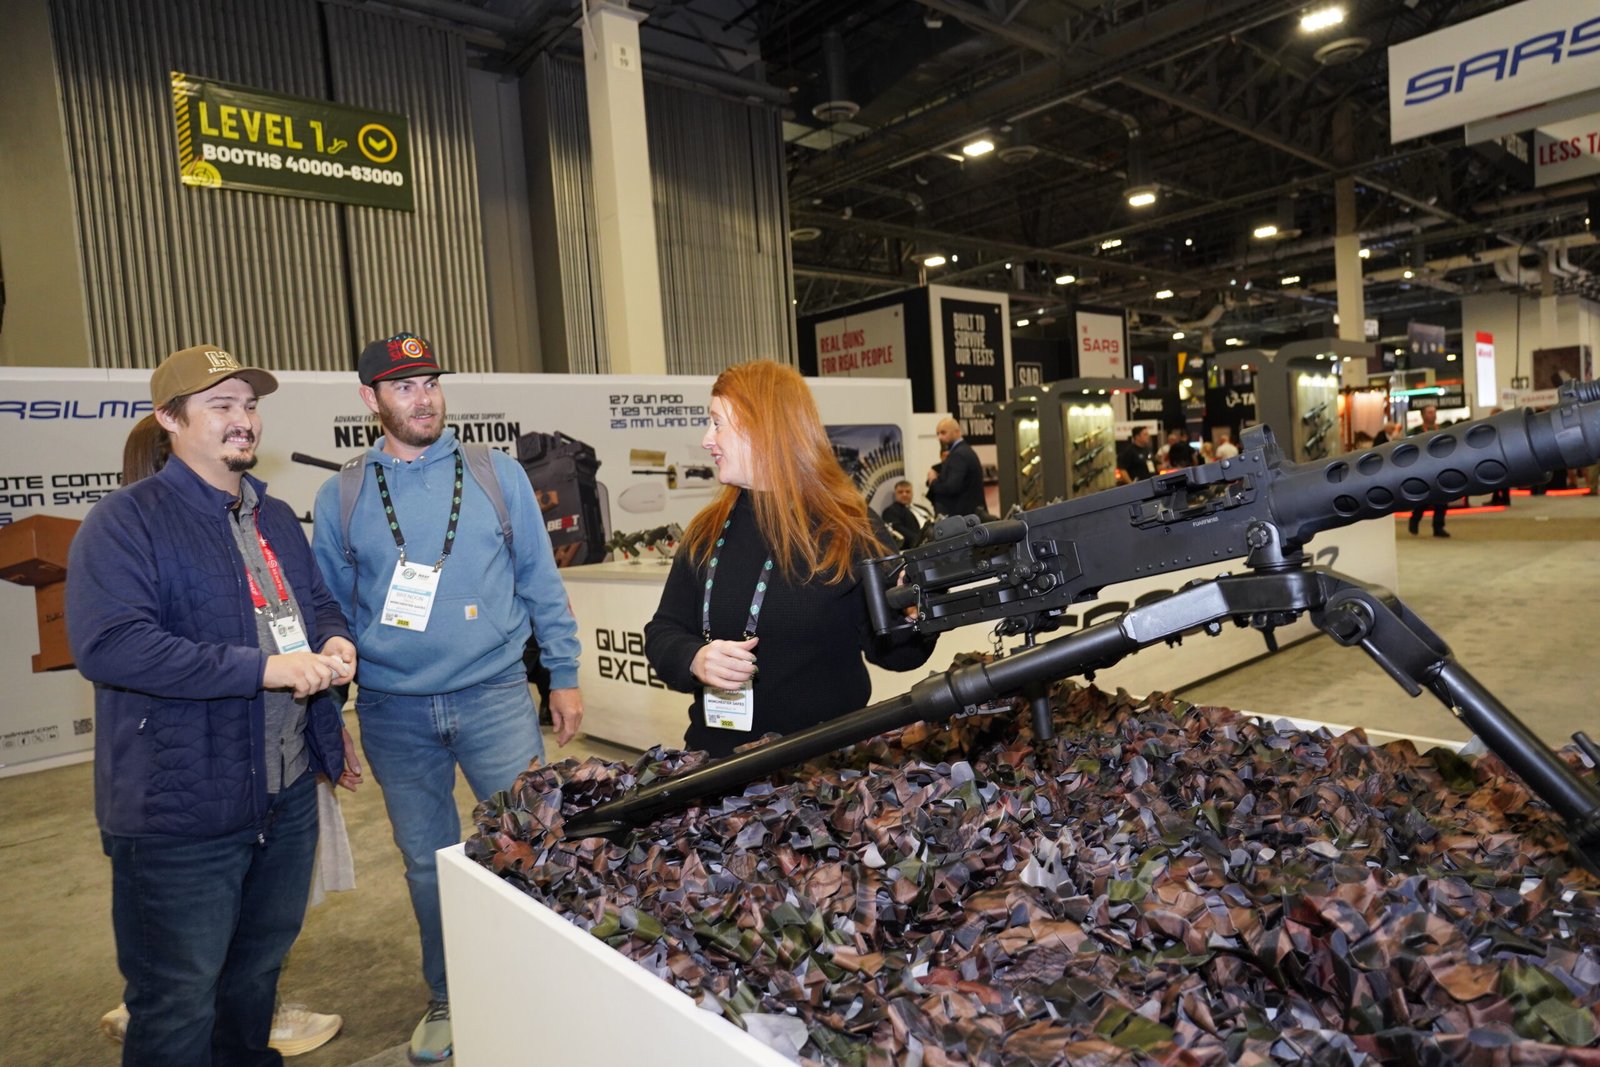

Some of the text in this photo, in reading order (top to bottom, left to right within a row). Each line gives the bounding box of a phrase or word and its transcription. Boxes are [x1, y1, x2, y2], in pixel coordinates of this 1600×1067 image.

[199, 101, 324, 152] LEVEL 1
[1539, 137, 1582, 166] LESS
[202, 143, 403, 186] BOOTHS 40000-63000
[953, 312, 985, 331] BUILT TO
[820, 329, 865, 354] REAL GUNS
[954, 330, 985, 348] SURVIVE
[1082, 337, 1119, 354] SAR9
[822, 345, 893, 375] FOR REAL PEOPLE
[955, 347, 994, 366] OUR TESTS
[660, 394, 684, 404] POD
[957, 384, 993, 402] READY TO
[643, 405, 705, 416] TURRETED
[1139, 398, 1163, 412] TAURUS
[334, 415, 363, 423] ADVANCE
[481, 412, 506, 420] SUPPORT
[656, 417, 688, 427] LAND
[333, 424, 385, 449] NEW
[969, 419, 994, 436] YOURS
